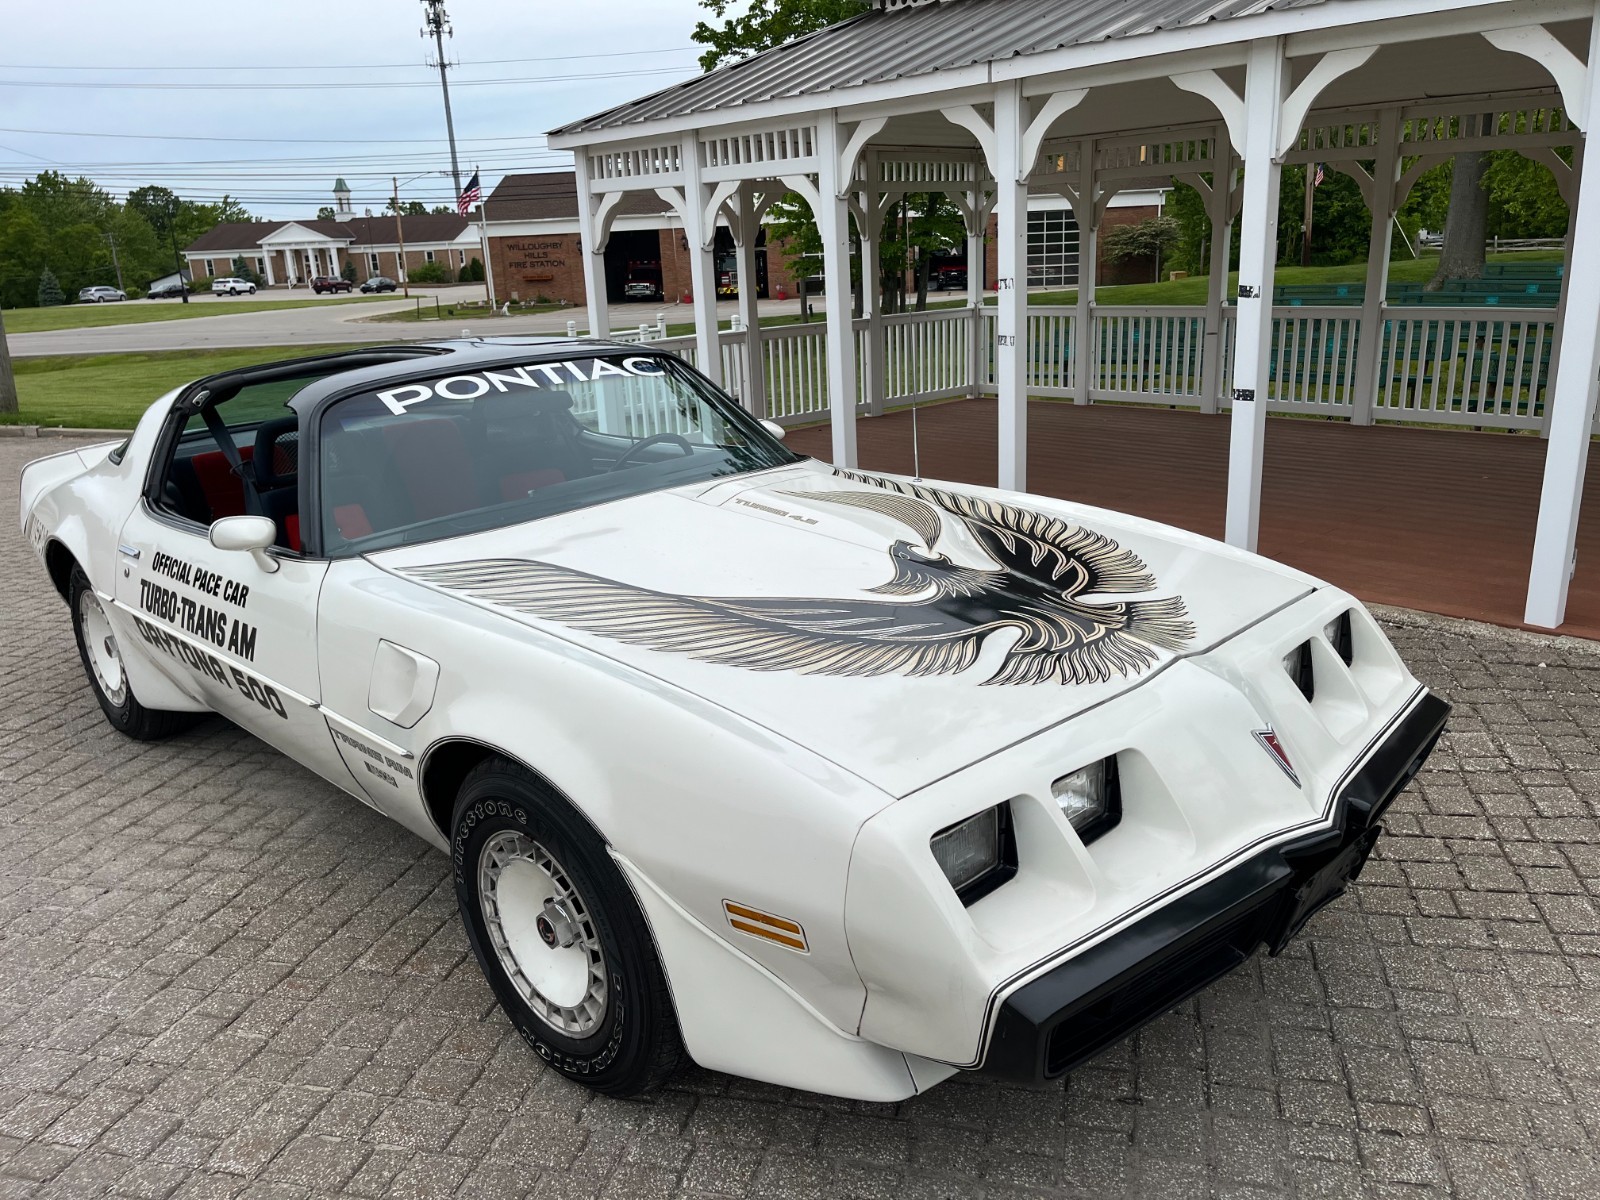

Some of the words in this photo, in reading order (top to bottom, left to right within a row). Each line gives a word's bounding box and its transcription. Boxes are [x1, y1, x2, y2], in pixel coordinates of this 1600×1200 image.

[507, 241, 563, 251] WILLOUGHBY
[509, 261, 528, 269] FIRE
[529, 260, 566, 268] STATION
[376, 357, 665, 416] PONTIAC
[152, 551, 192, 586] OFFICIAL
[192, 567, 223, 597] PACE
[223, 579, 250, 608] CAR
[140, 578, 228, 648] TURBO-TRANS
[228, 618, 257, 663] AM
[132, 614, 233, 690] DAYTONA
[229, 664, 288, 720] 500
[329, 726, 384, 764] TRANS
[454, 800, 528, 885] Firestone
[521, 971, 626, 1075] DESTINATION
